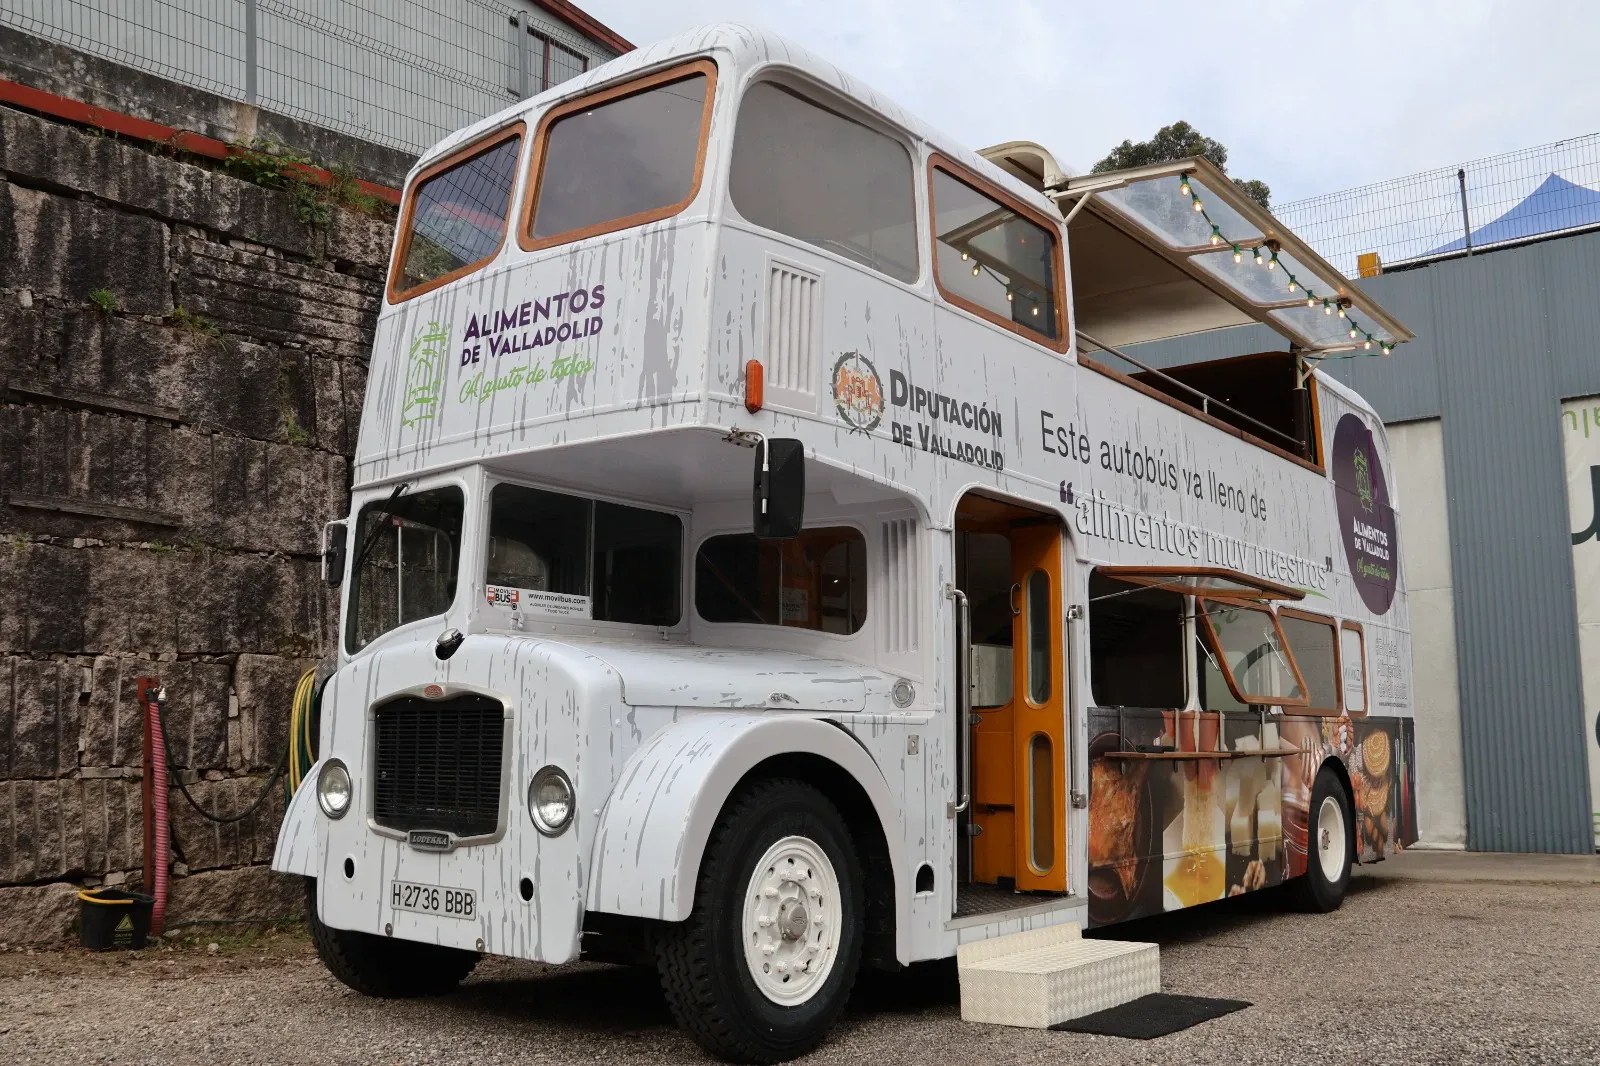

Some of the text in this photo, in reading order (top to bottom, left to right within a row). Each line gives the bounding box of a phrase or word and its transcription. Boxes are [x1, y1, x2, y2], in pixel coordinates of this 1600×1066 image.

[463, 285, 606, 342] ALIMENTOS
[461, 316, 604, 367] DE VALLADOLID
[481, 365, 528, 404] gusto
[526, 361, 548, 386] de
[550, 353, 595, 379] todos
[889, 368, 1003, 438] DIPUTACIÓN
[891, 420, 1004, 471] DE VALLADOLID
[1040, 409, 1267, 522] Este autobús va lleno de
[1206, 531, 1248, 573] muy
[1353, 515, 1388, 547] ALIMENTOS
[1362, 537, 1390, 561] VALLADOLID
[495, 593, 511, 603] BUS
[528, 593, 586, 605] www.movilbus.com
[411, 834, 449, 845] LODEKKA
[404, 885, 440, 911] 2736
[445, 890, 474, 916] BBB
